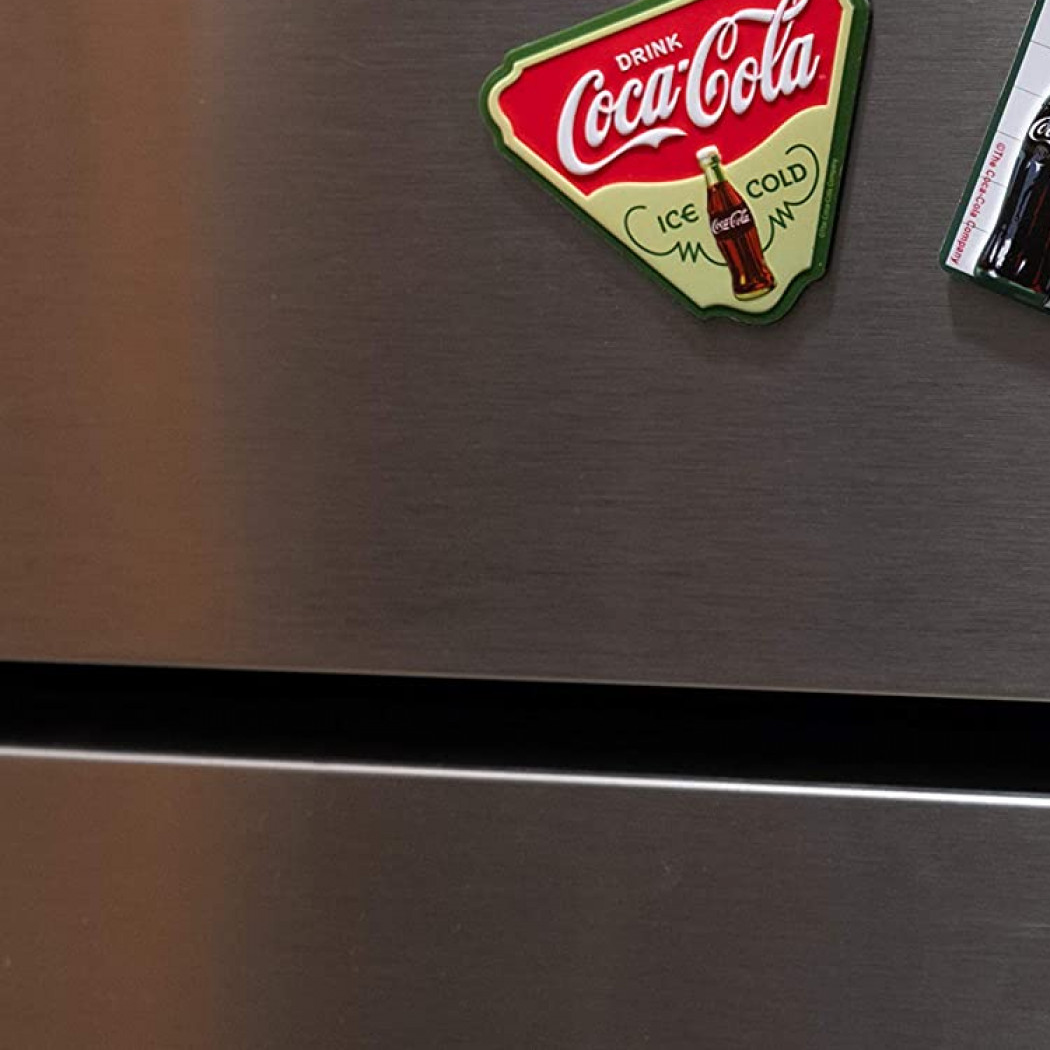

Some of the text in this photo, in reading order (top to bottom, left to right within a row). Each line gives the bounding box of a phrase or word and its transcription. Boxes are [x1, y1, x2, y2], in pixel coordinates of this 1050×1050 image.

[615, 33, 684, 72] DRINK
[657, 203, 699, 233] ICE
[745, 163, 808, 199] COLD
[951, 220, 977, 265] Company
